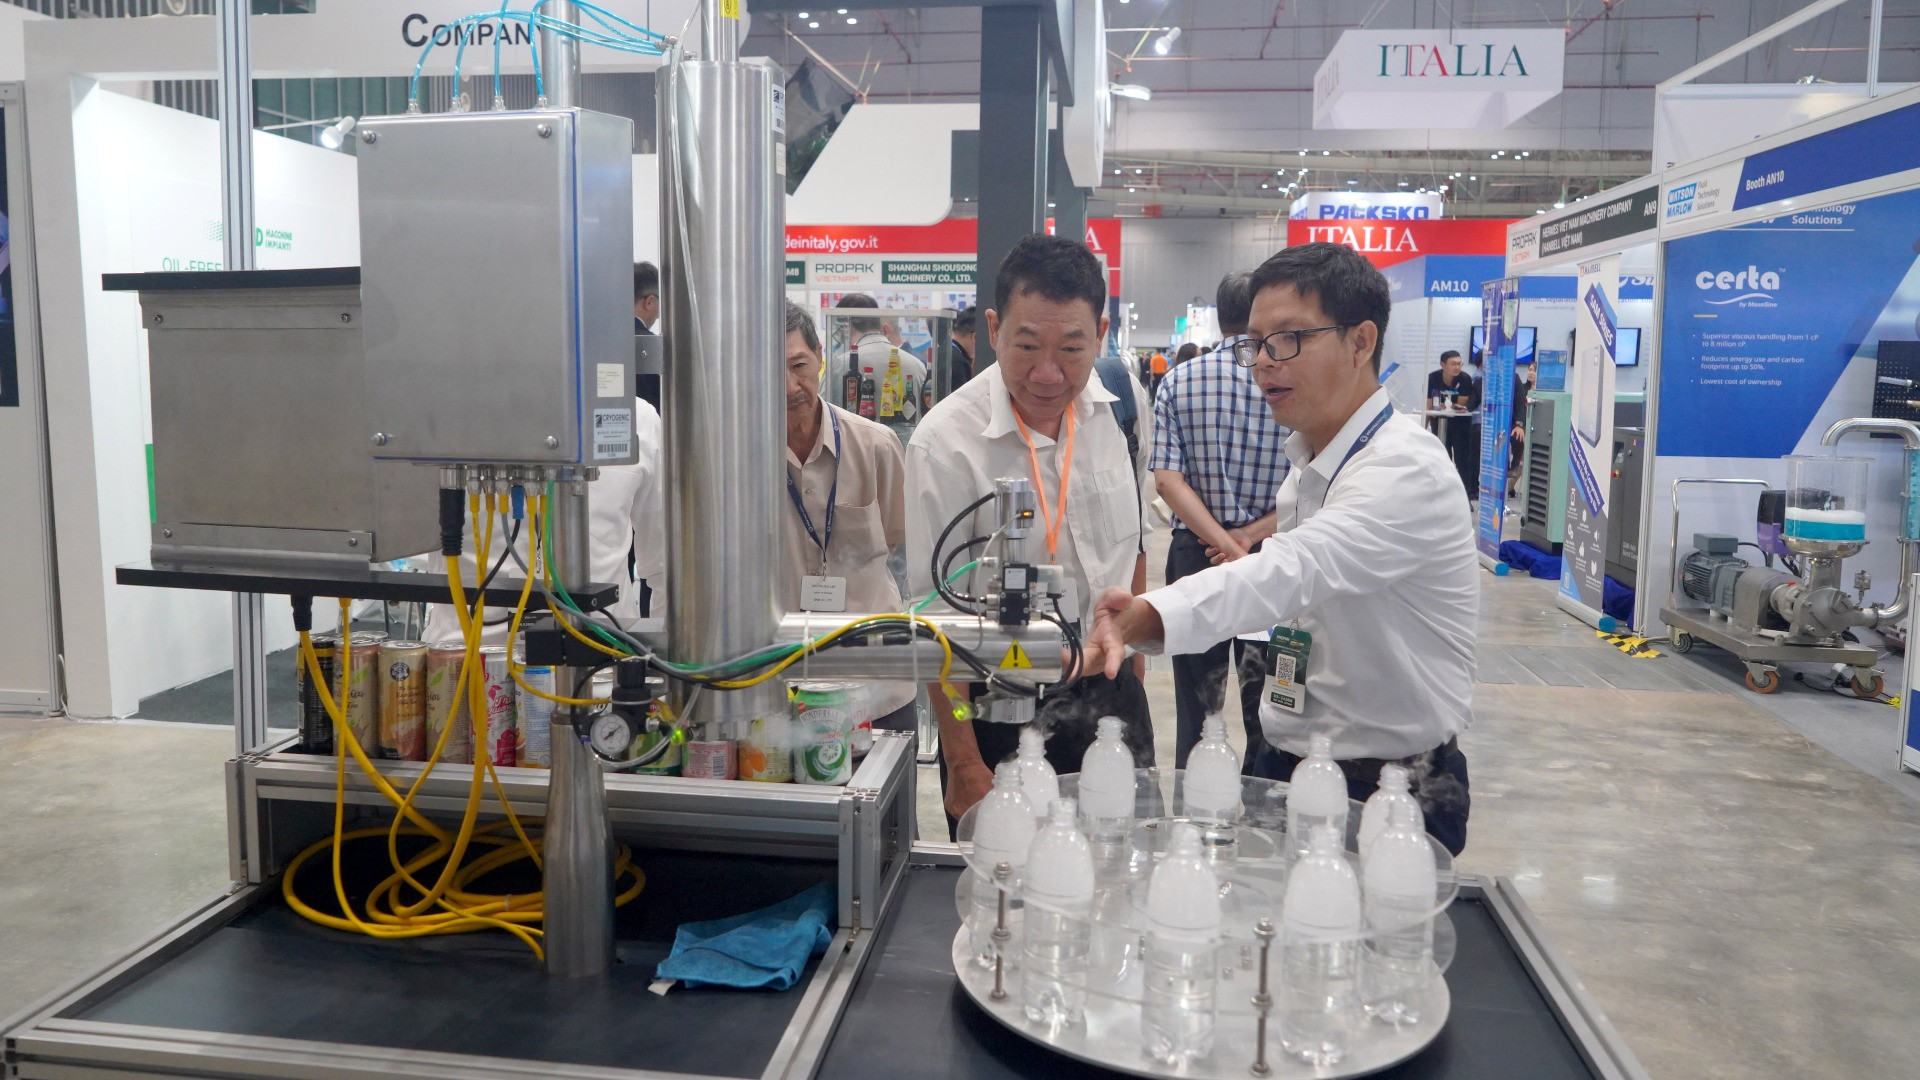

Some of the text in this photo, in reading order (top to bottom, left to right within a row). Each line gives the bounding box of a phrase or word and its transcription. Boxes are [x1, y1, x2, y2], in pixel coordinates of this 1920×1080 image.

[402, 13, 541, 47] COMPAN
[1377, 44, 1529, 77] ITALIA
[1746, 170, 1784, 191] Booth AN10
[1669, 184, 1695, 204] WATSON
[1667, 202, 1693, 217] MARLOW
[1542, 198, 1657, 238] HERMES VIET NAM MACHINERY COMPANY AN9
[1792, 215, 1843, 224] Solutions
[265, 229, 292, 240] MACCHINE
[1308, 226, 1419, 252] ITALIA
[265, 240, 291, 250] IMPIANTI
[1512, 231, 1537, 251] PROPAK
[816, 263, 874, 274] PROPAK
[888, 263, 931, 272] SHANGHAI
[816, 275, 860, 283] VIETNAM
[938, 275, 954, 283] CO.,
[1696, 266, 1780, 290] certa
[1431, 280, 1469, 292] AM10
[1702, 333, 1730, 341] Superior
[1757, 333, 1786, 341] handling
[1700, 363, 1730, 371] footprint
